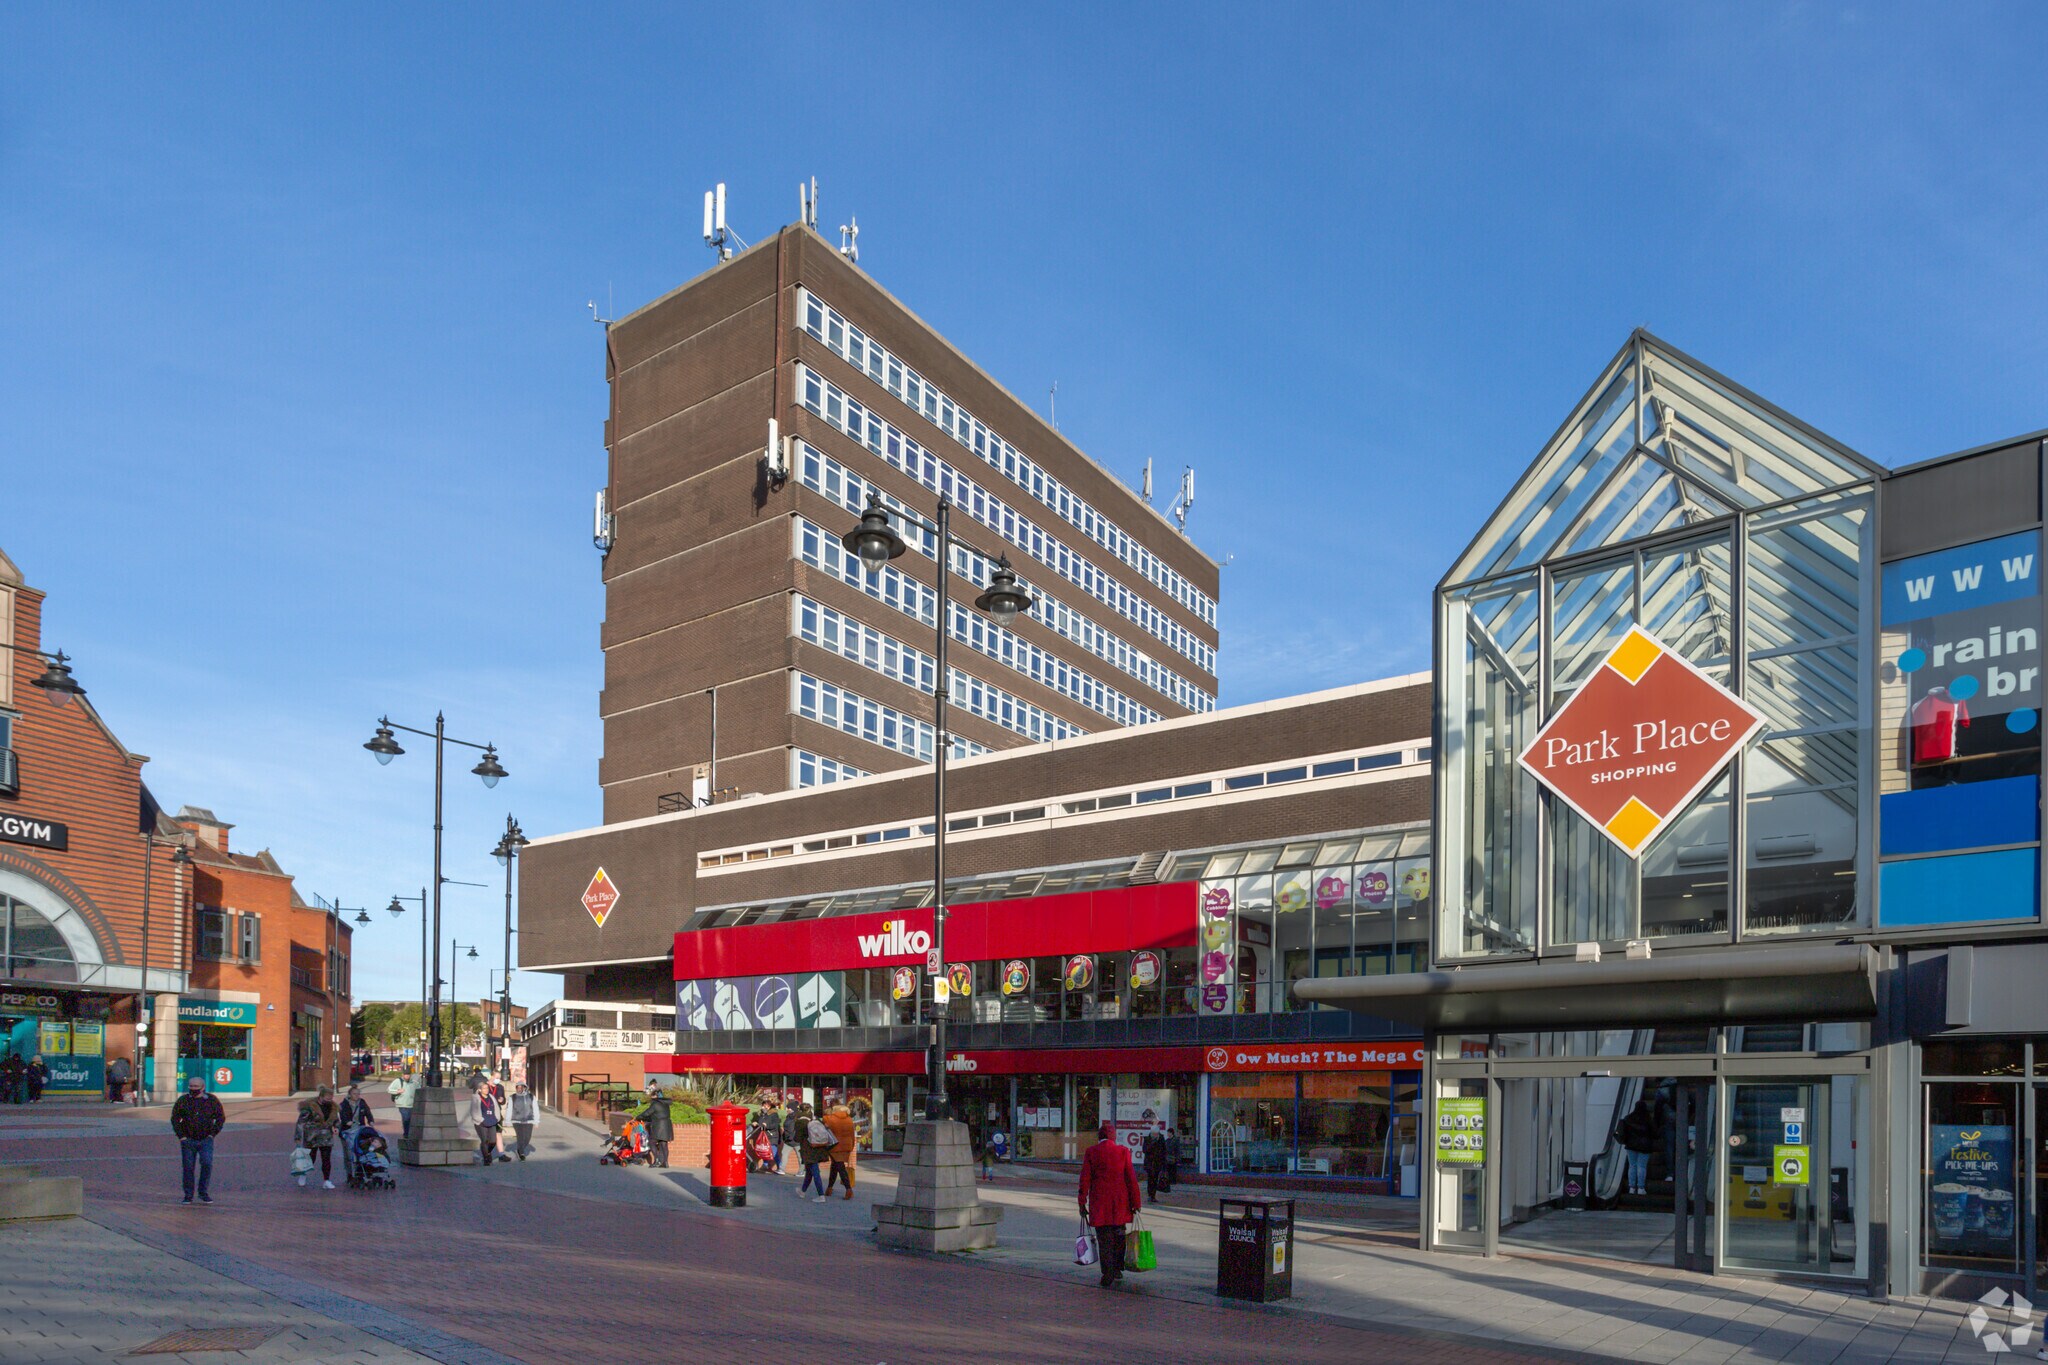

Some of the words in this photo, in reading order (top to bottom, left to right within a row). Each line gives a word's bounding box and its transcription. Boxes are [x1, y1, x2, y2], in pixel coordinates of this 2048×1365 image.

[1933, 625, 2037, 668] rain
[1544, 729, 1621, 769] Park
[1632, 717, 1731, 755] Place
[1590, 761, 1677, 784] SHOPPING
[0, 816, 51, 842] GYM
[585, 893, 598, 903] Park
[599, 892, 615, 902] Place
[858, 919, 931, 958] wilko
[178, 1006, 228, 1018] undland
[556, 1029, 568, 1048] 15
[1236, 1054, 1259, 1064] Ow
[1267, 1051, 1318, 1064] Much?
[1324, 1051, 1356, 1063] The
[1362, 1050, 1406, 1064] Mega
[50, 1069, 89, 1082] Today!
[217, 1070, 231, 1082] £1
[1951, 1147, 1992, 1160] Festive
[1945, 1161, 1999, 1171] PICK-ME-UPS
[1229, 1225, 1256, 1237] Walsall
